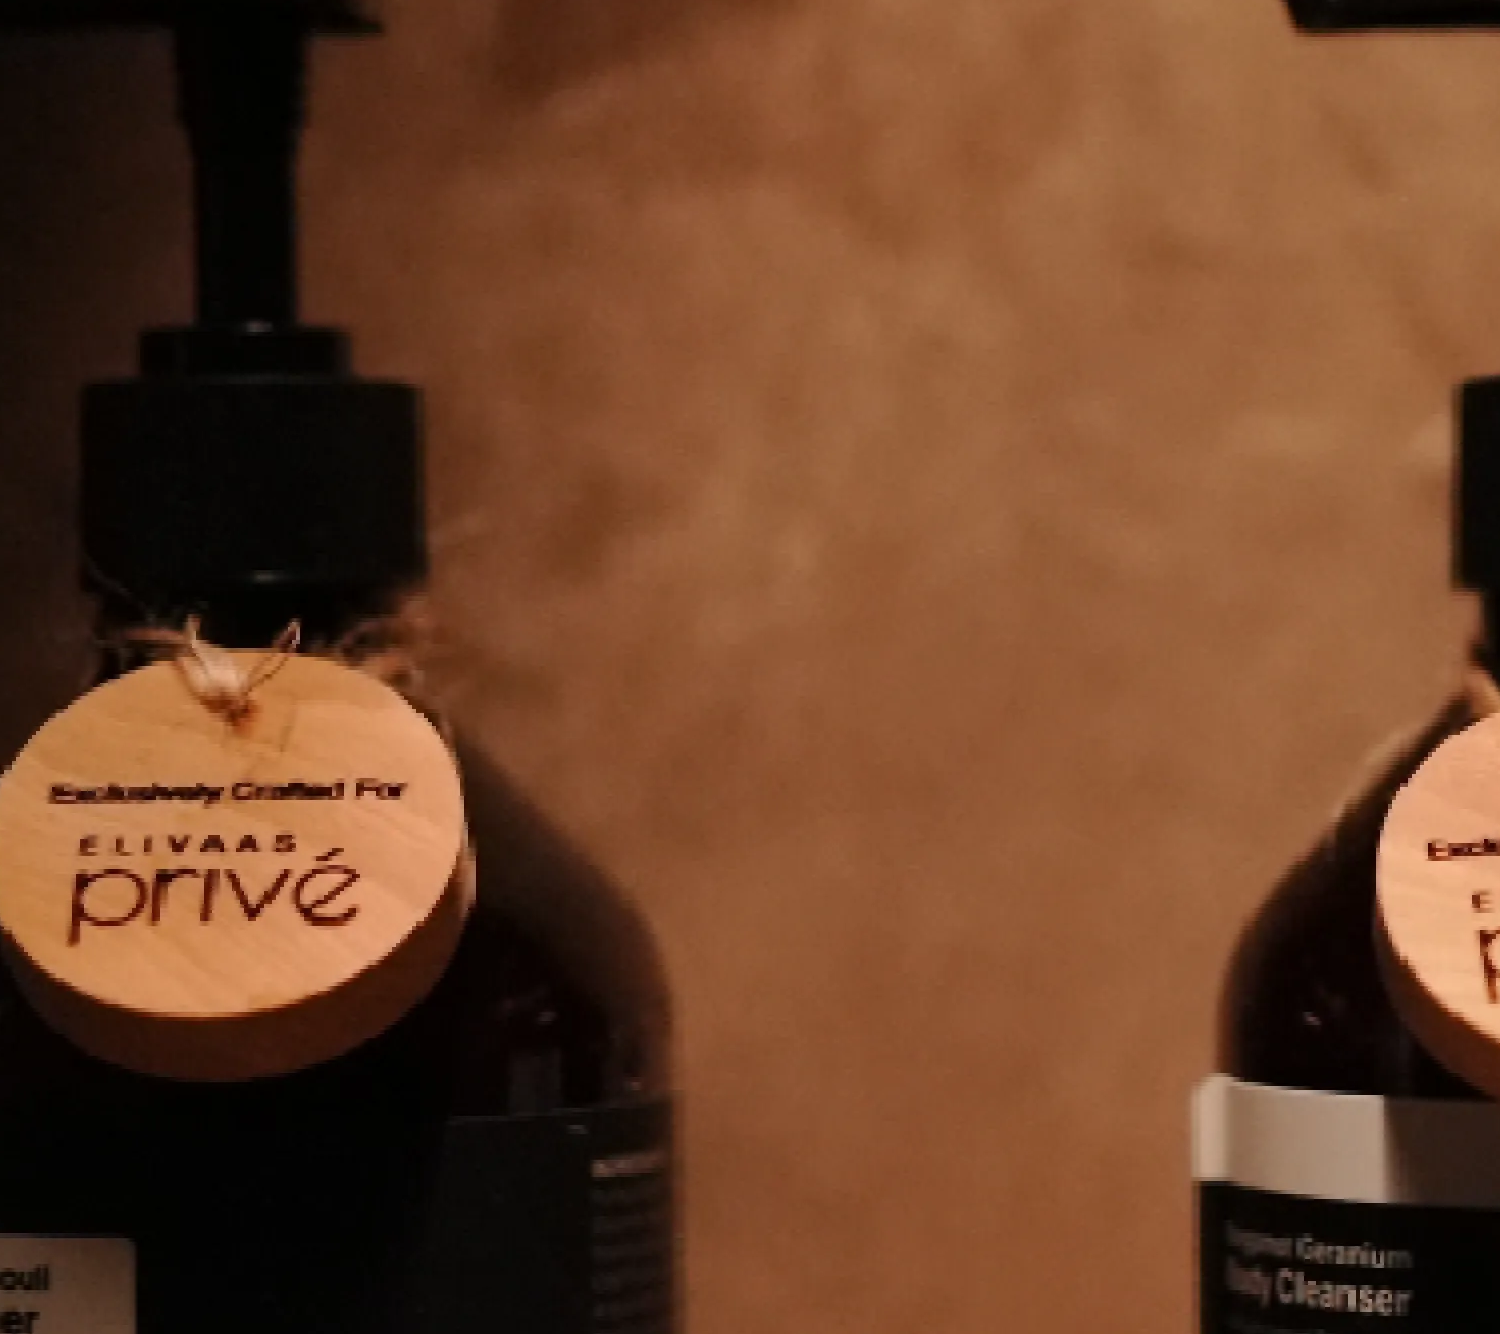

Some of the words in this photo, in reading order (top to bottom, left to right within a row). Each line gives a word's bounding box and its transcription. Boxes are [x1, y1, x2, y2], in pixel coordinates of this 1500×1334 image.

[47, 781, 224, 807] Exclusively
[231, 779, 344, 803] Crafted
[355, 778, 407, 800] For
[78, 834, 297, 857] ELIVAAS
[66, 846, 361, 948] privé
[1296, 1233, 1414, 1270] Geranium
[1276, 1267, 1415, 1317] Cleanser
